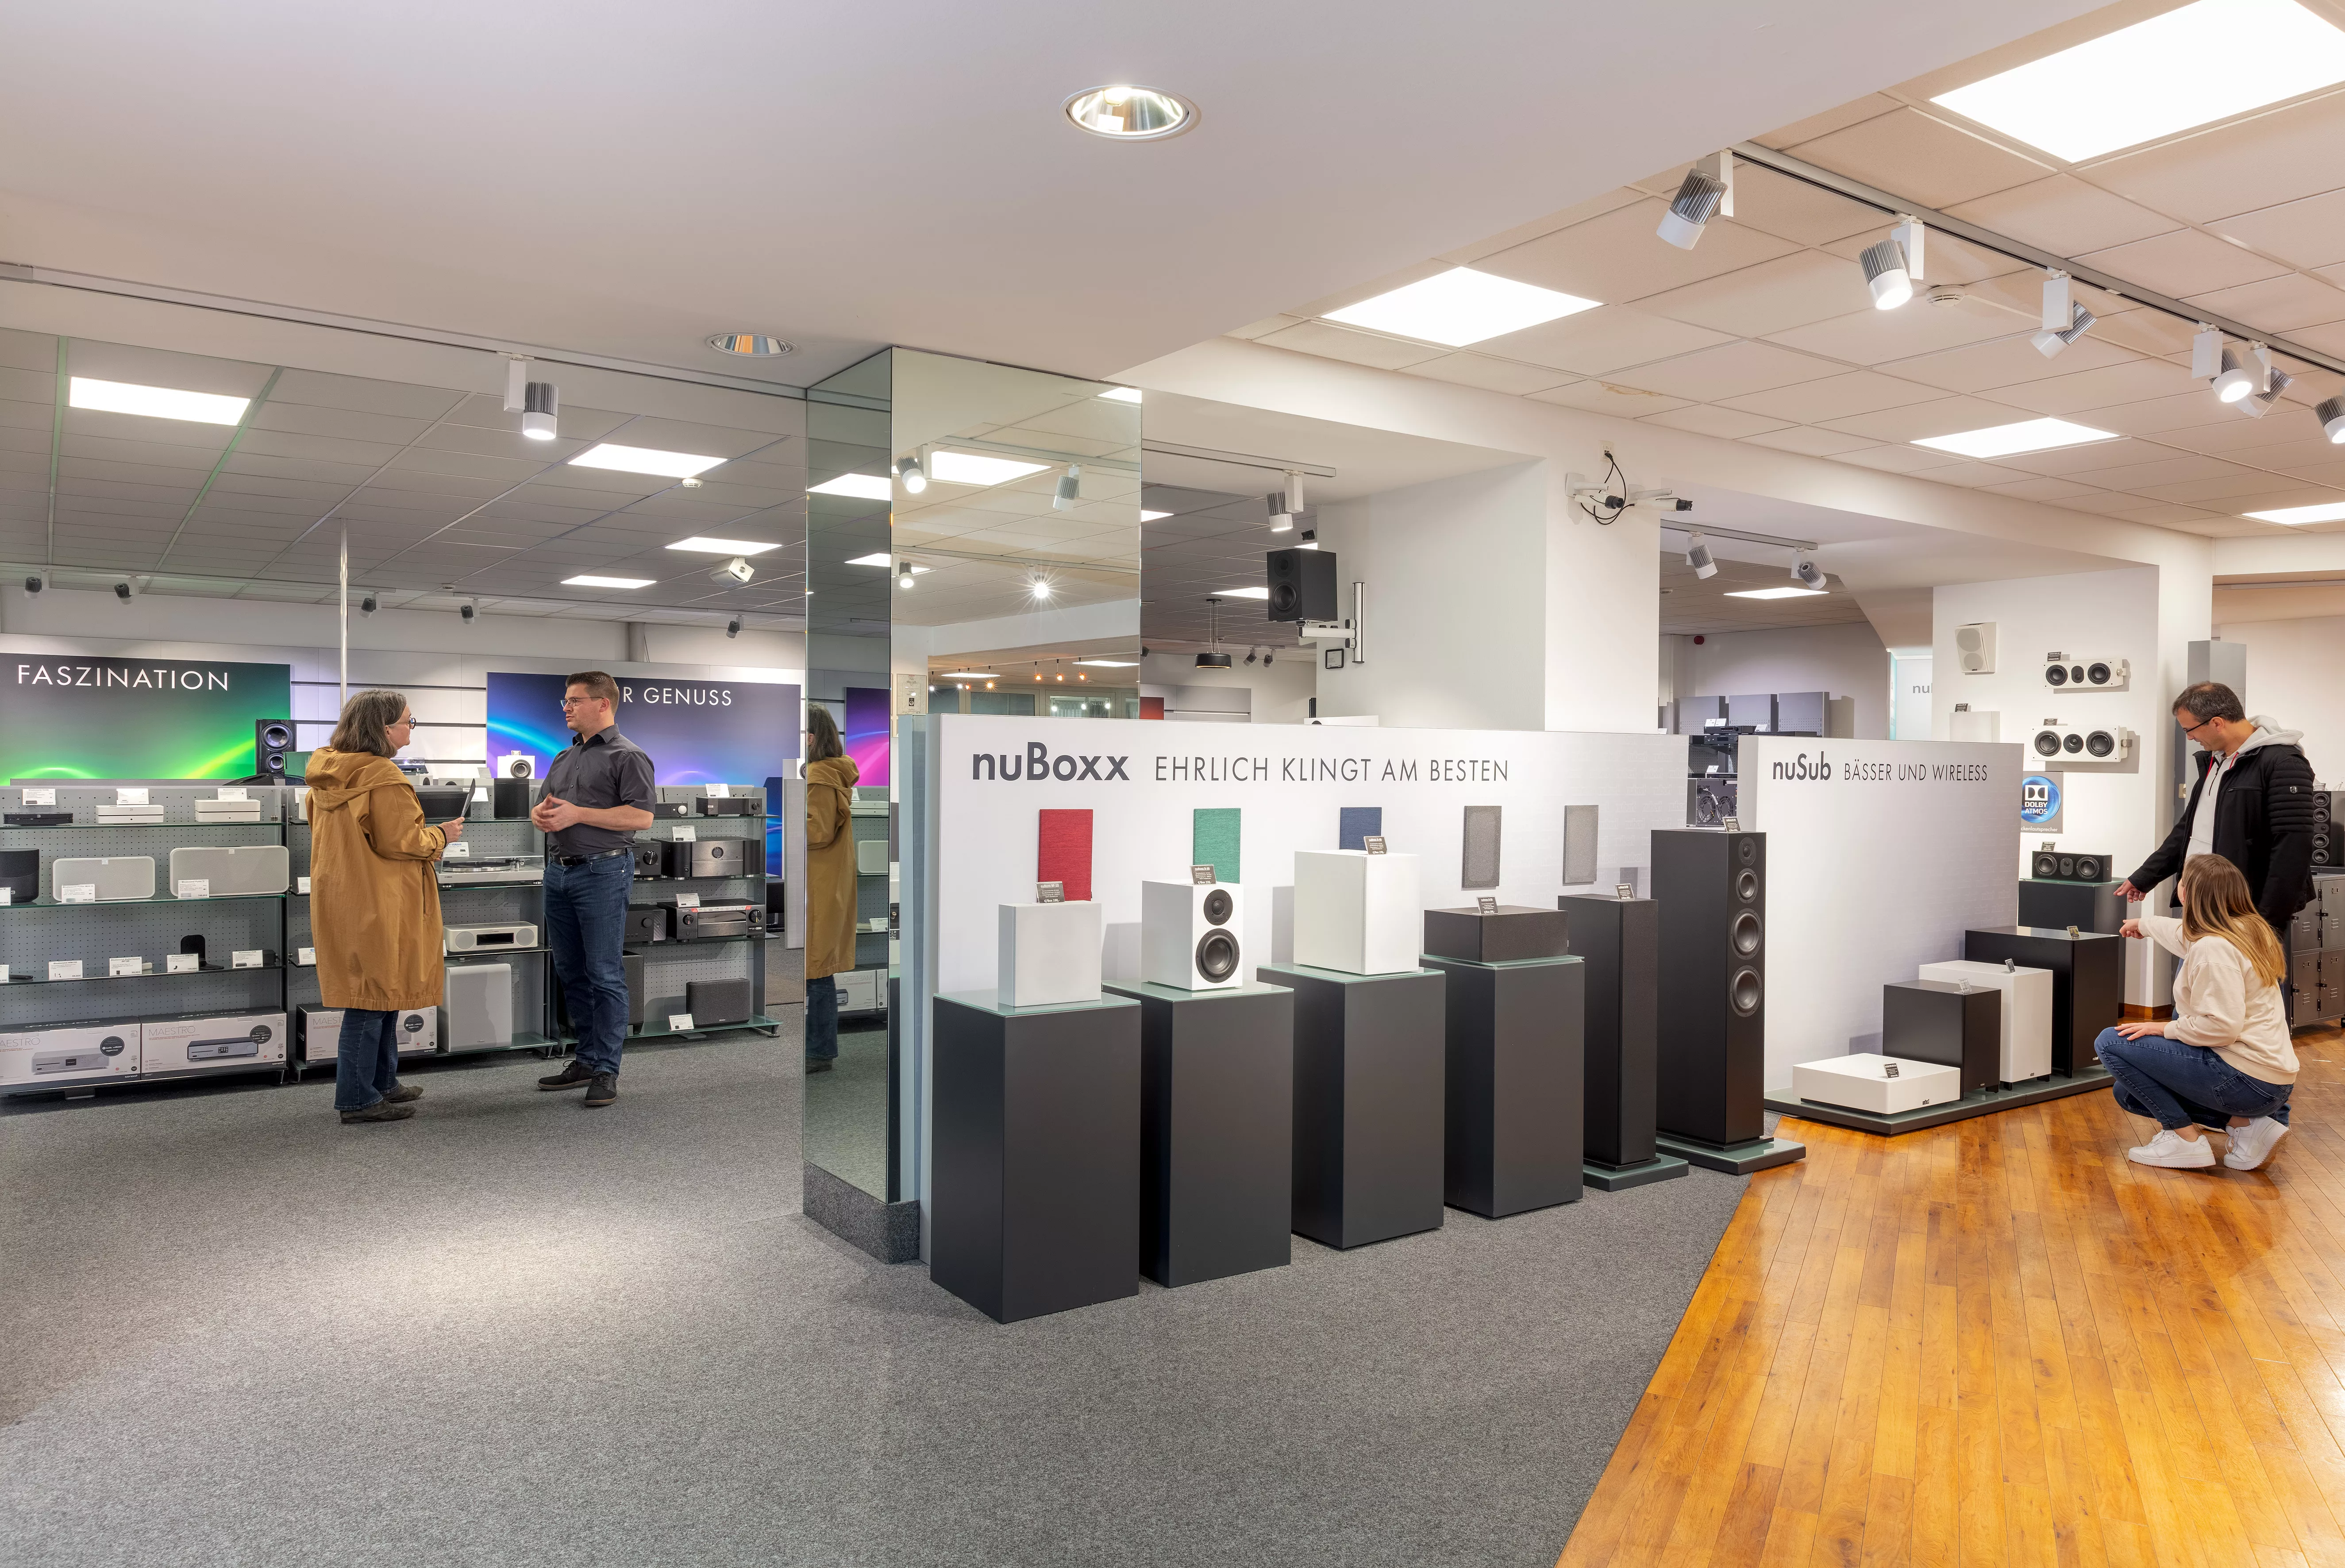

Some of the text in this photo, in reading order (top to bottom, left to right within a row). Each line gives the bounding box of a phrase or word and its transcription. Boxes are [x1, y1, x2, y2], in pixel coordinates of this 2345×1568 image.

[18, 665, 228, 691] FASZINATION
[644, 687, 732, 706] GENUSS
[973, 742, 1507, 782] nuBoxx EHRLICH KLINGT AM BESTEN
[1772, 751, 1987, 781] nuSub BÄSSER UND WIRELESS
[149, 1026, 196, 1036] MAESTRO
[313, 1016, 342, 1025] MAEST
